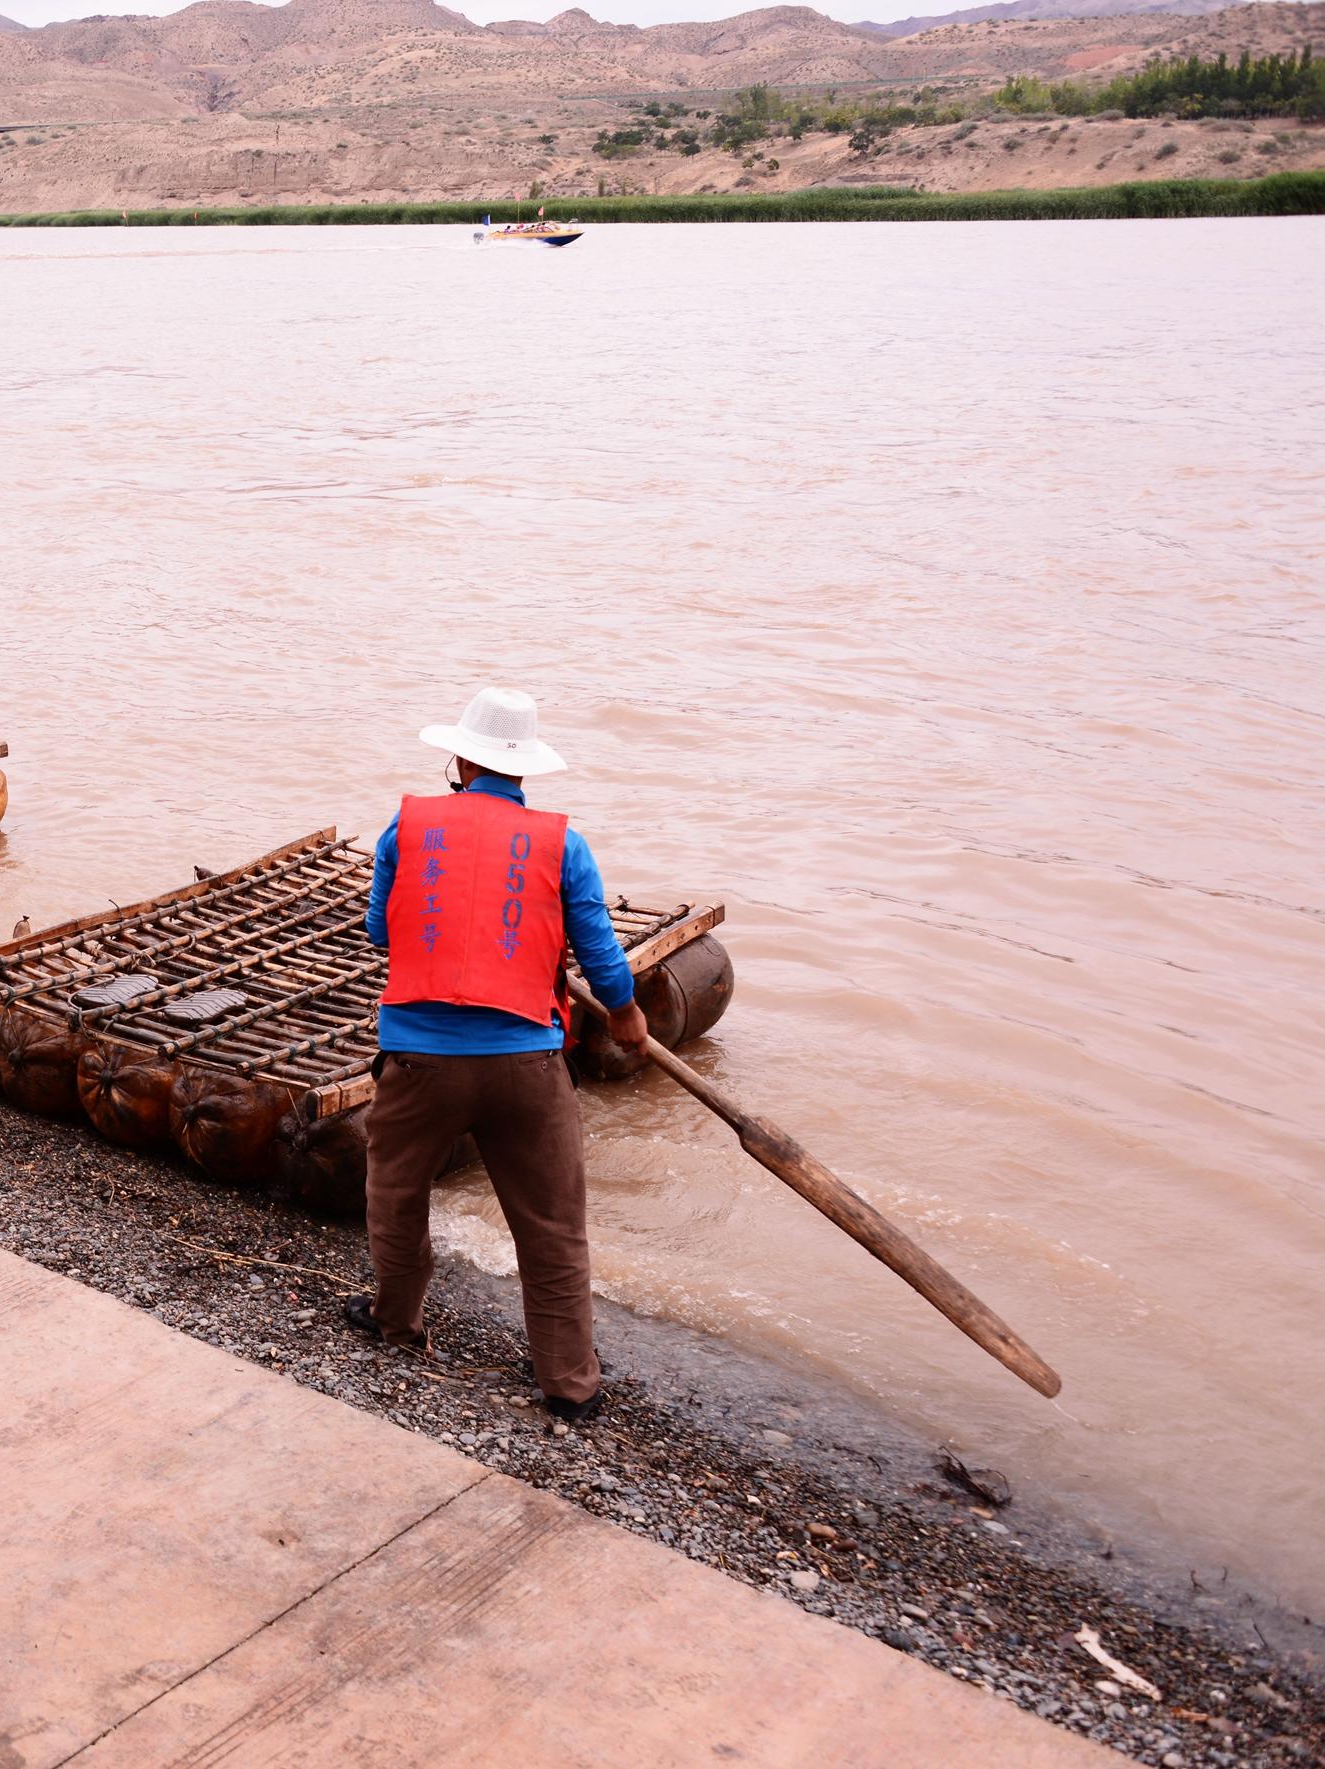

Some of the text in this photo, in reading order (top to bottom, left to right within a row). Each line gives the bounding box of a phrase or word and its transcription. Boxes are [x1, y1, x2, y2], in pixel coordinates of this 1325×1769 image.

[418, 828, 449, 953] 服务工号
[495, 832, 532, 961] 050号
